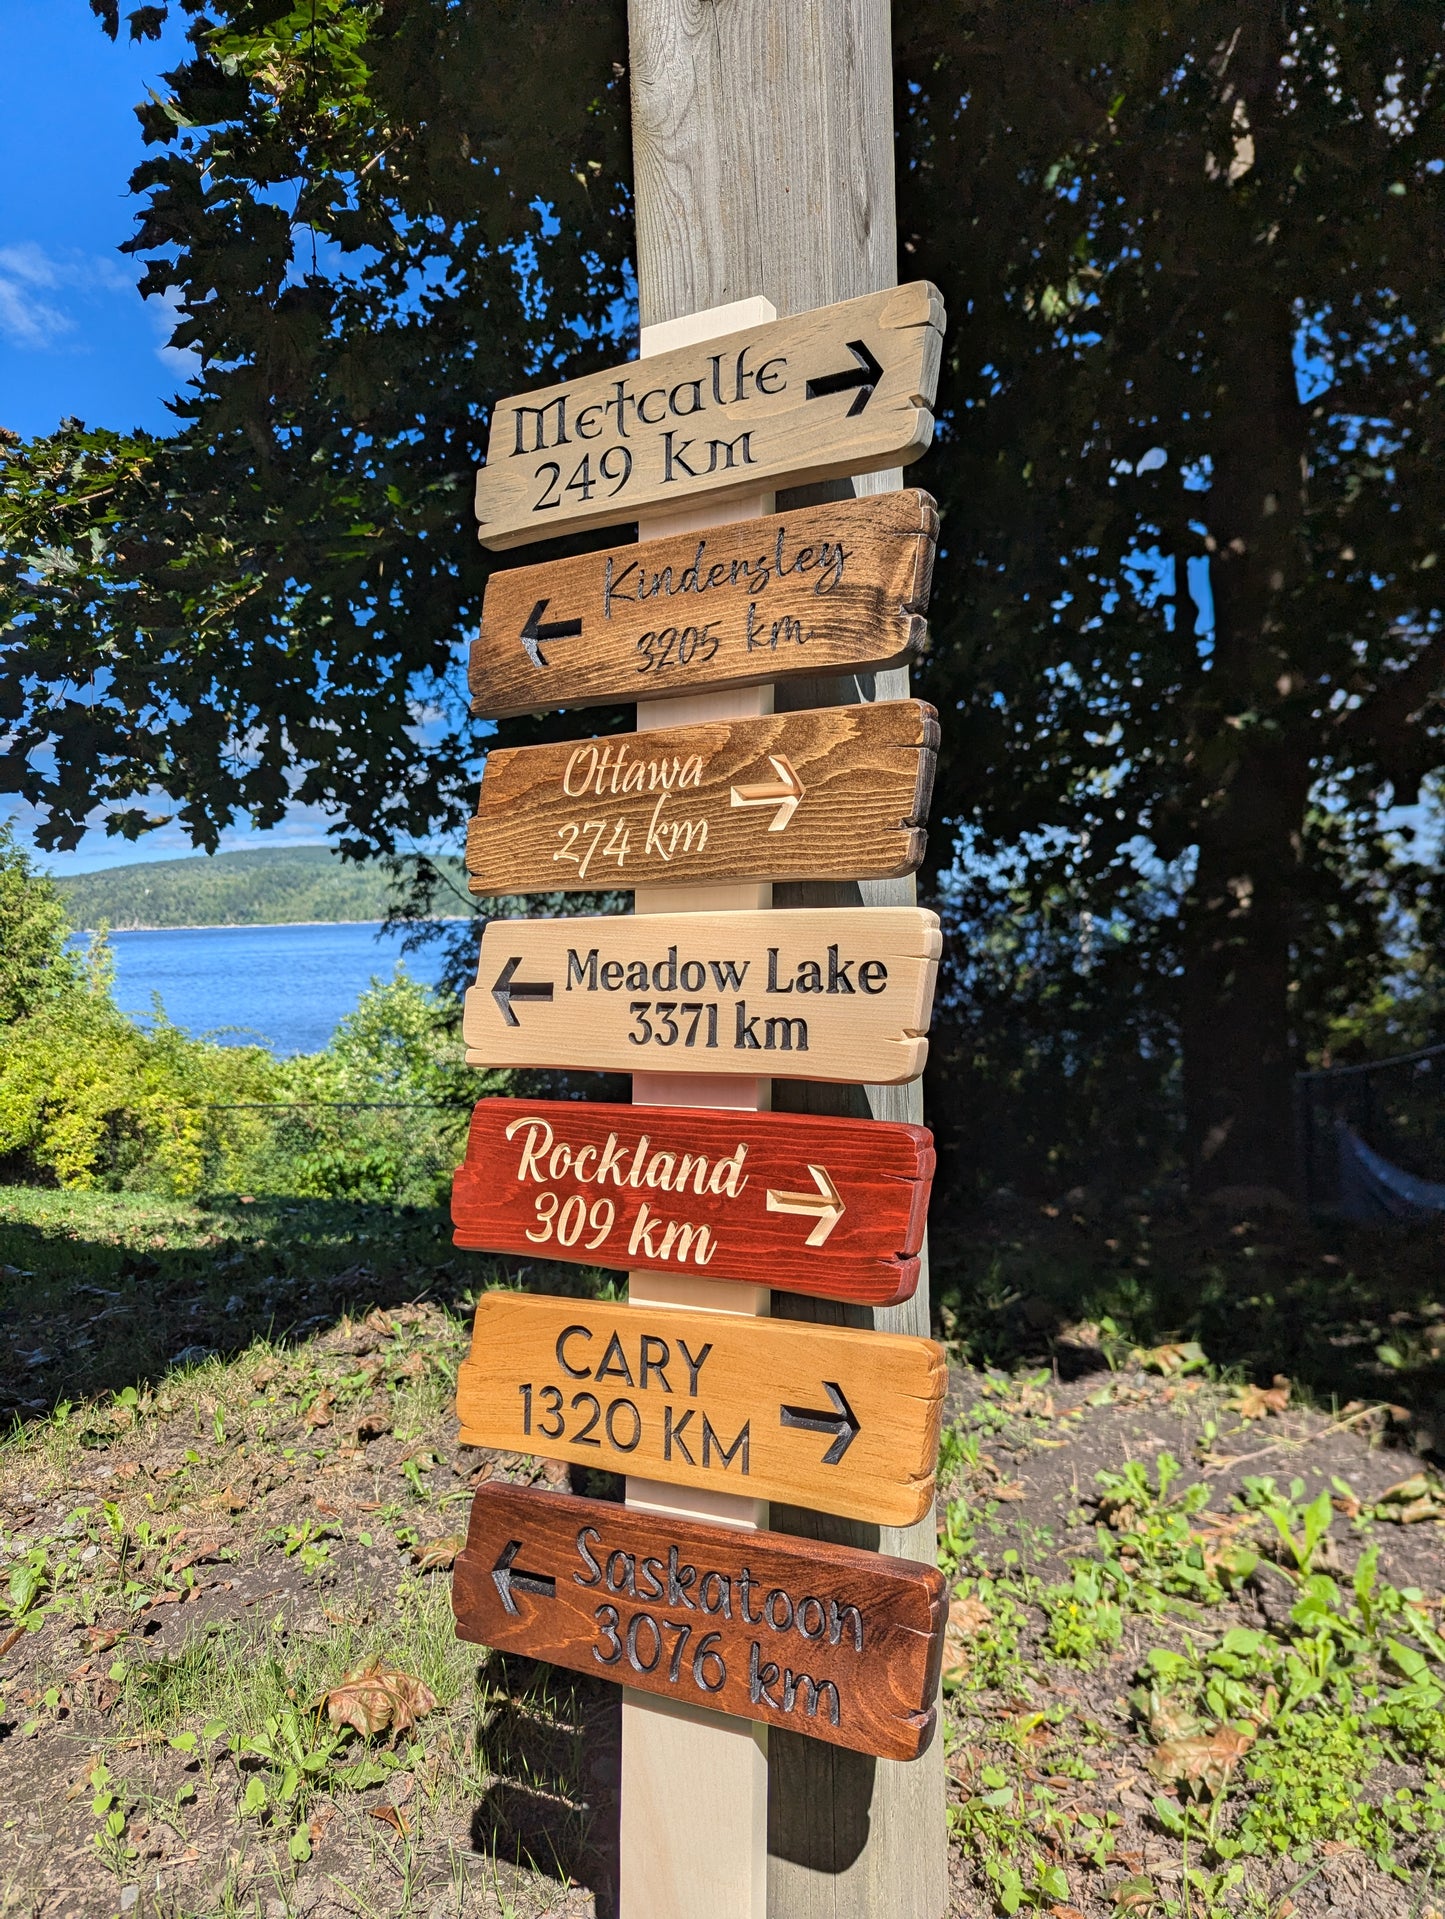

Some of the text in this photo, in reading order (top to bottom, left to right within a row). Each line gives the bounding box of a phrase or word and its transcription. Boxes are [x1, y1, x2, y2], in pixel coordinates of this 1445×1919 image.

[509, 346, 788, 457] Metcalfe
[532, 445, 632, 512] 249
[604, 527, 852, 619] Kindersley
[636, 602, 812, 673] 3205 km
[563, 744, 704, 797] Ottawa
[553, 792, 709, 878] 274 km
[565, 943, 888, 995] Meadow Lake
[628, 1000, 809, 1051] 3371 km
[505, 1117, 749, 1198] Rockland
[525, 1191, 717, 1265] 309 km
[556, 1325, 713, 1397] CARY
[518, 1383, 750, 1475] 1320 KM
[572, 1526, 864, 1653] Saskatoon
[593, 1604, 840, 1727] 3076 km
